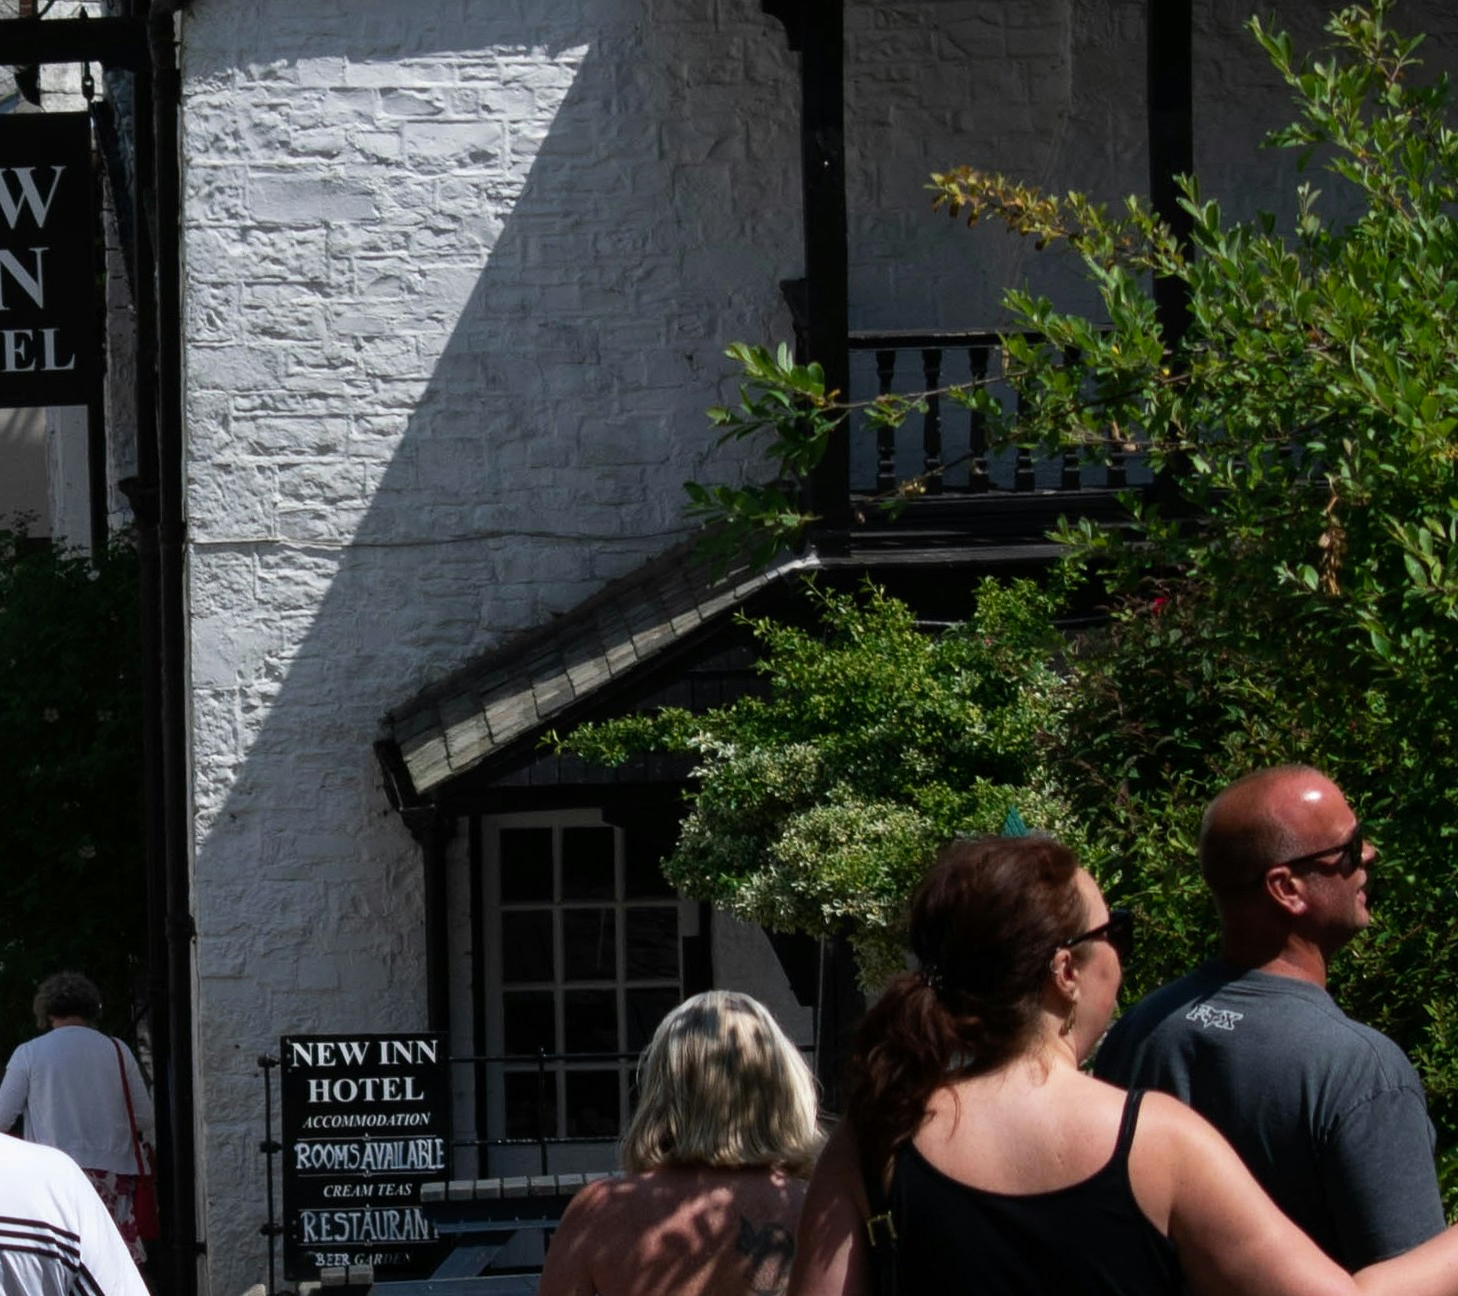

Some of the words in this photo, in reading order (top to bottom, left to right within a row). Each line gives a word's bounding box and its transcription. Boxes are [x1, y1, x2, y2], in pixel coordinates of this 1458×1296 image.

[291, 1041, 370, 1067] NEW
[378, 1039, 439, 1065] INN
[307, 1076, 425, 1103] HOTEL
[302, 1111, 432, 1130] ACCOMMODATION
[294, 1142, 361, 1170] ROOMS
[361, 1138, 446, 1170] AVAILABLE
[322, 1184, 374, 1198] CREAM
[377, 1183, 413, 1197] TEAS
[300, 1208, 440, 1243] RESTAURAN
[314, 1252, 352, 1267] BEER
